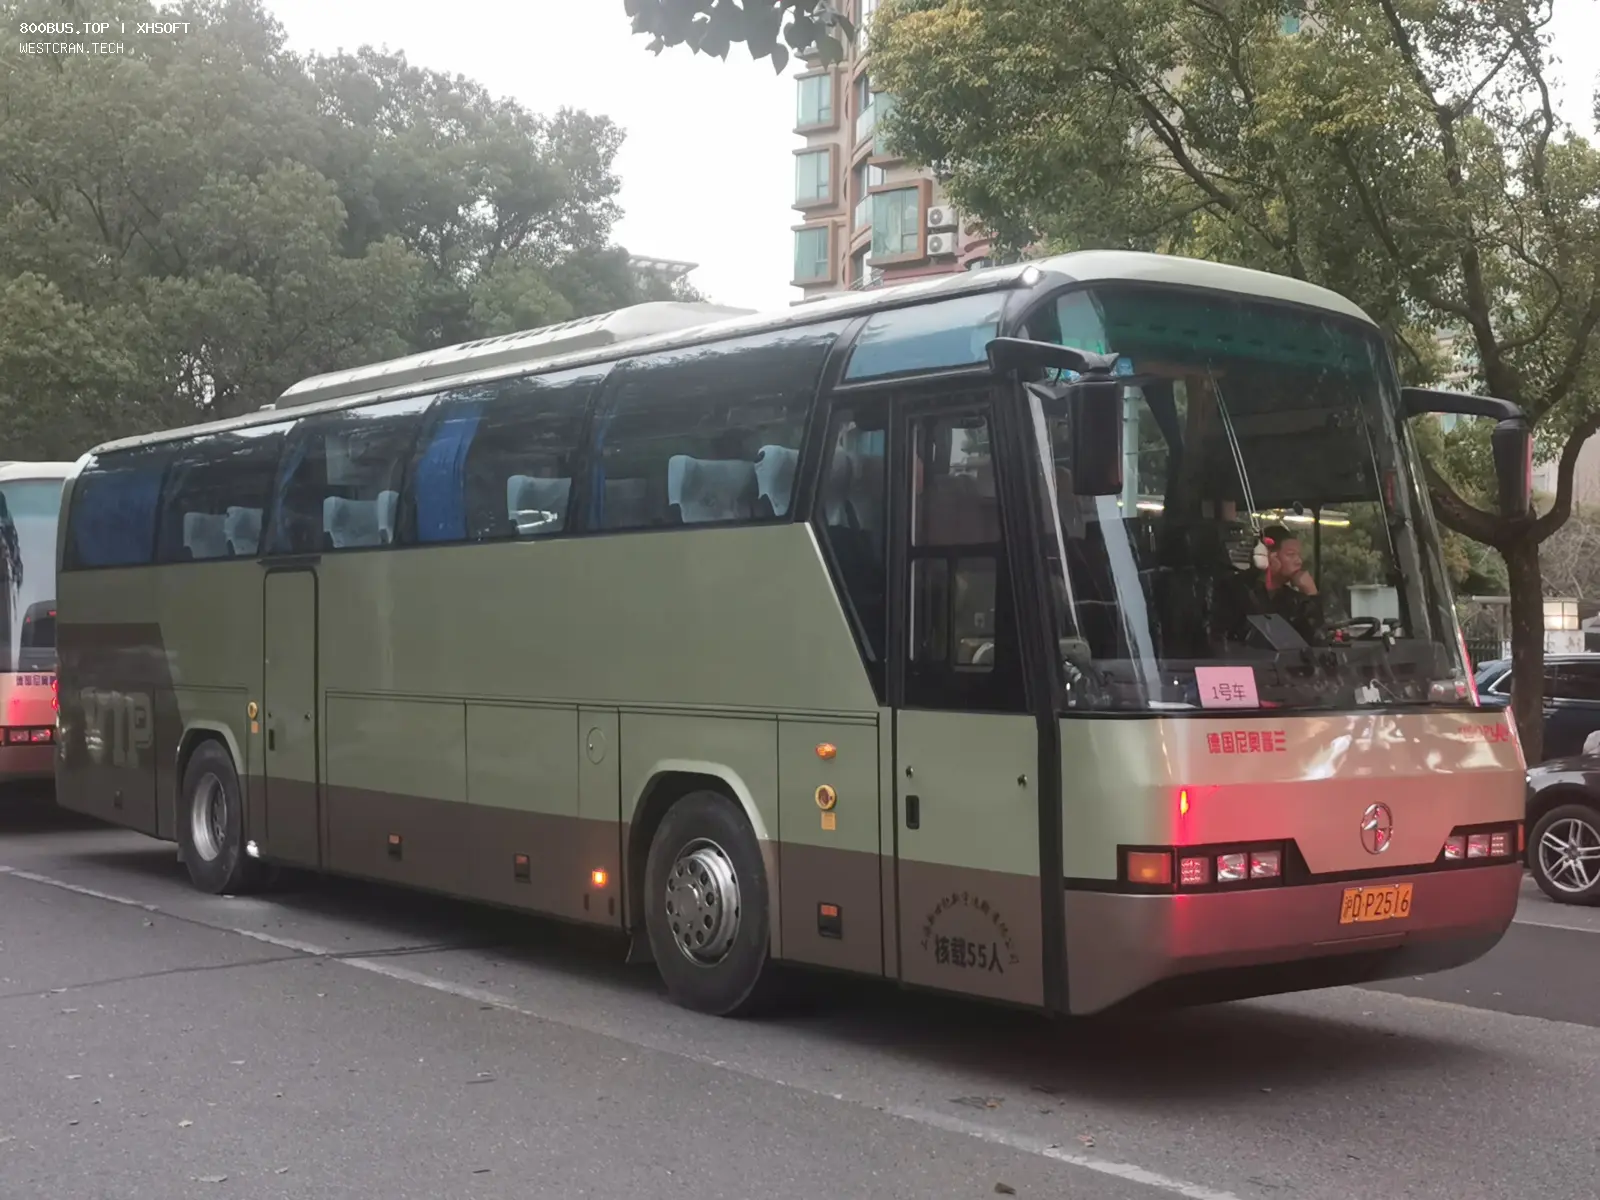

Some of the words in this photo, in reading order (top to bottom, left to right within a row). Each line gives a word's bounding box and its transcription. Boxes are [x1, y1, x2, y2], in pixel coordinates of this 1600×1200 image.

[1212, 682, 1247, 701] 1号车
[1207, 730, 1287, 753] 德国尼奥普兰
[934, 934, 1004, 974] 核载55人
